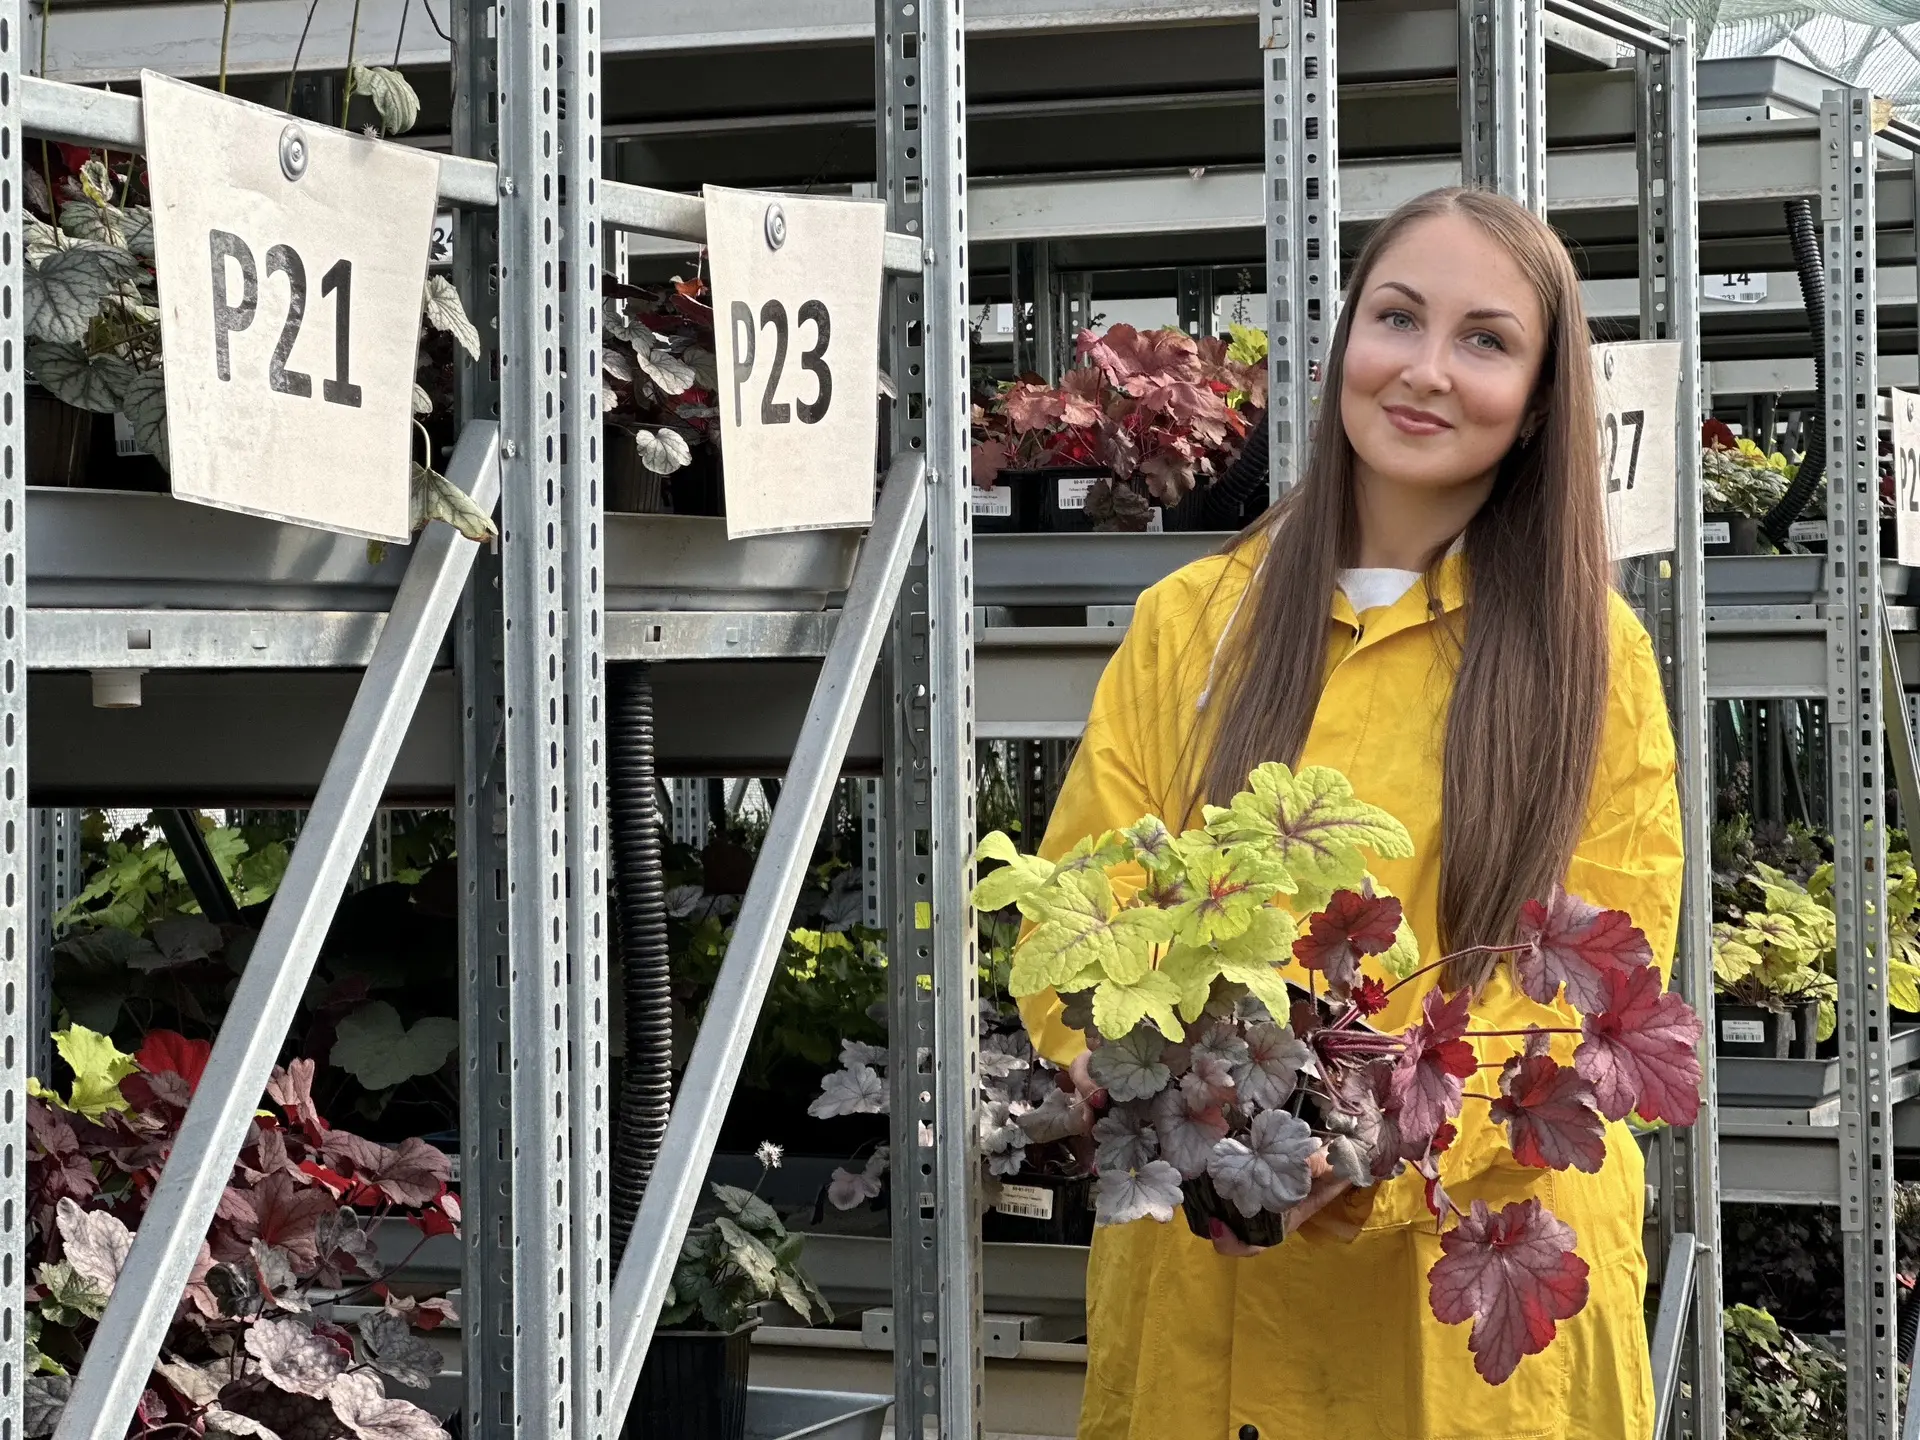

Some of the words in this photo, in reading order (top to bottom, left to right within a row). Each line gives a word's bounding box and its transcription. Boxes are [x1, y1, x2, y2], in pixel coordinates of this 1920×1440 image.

[209, 228, 362, 408] P21
[1722, 272, 1751, 287] 14
[731, 299, 832, 427] P23
[1900, 447, 1920, 512] P2
